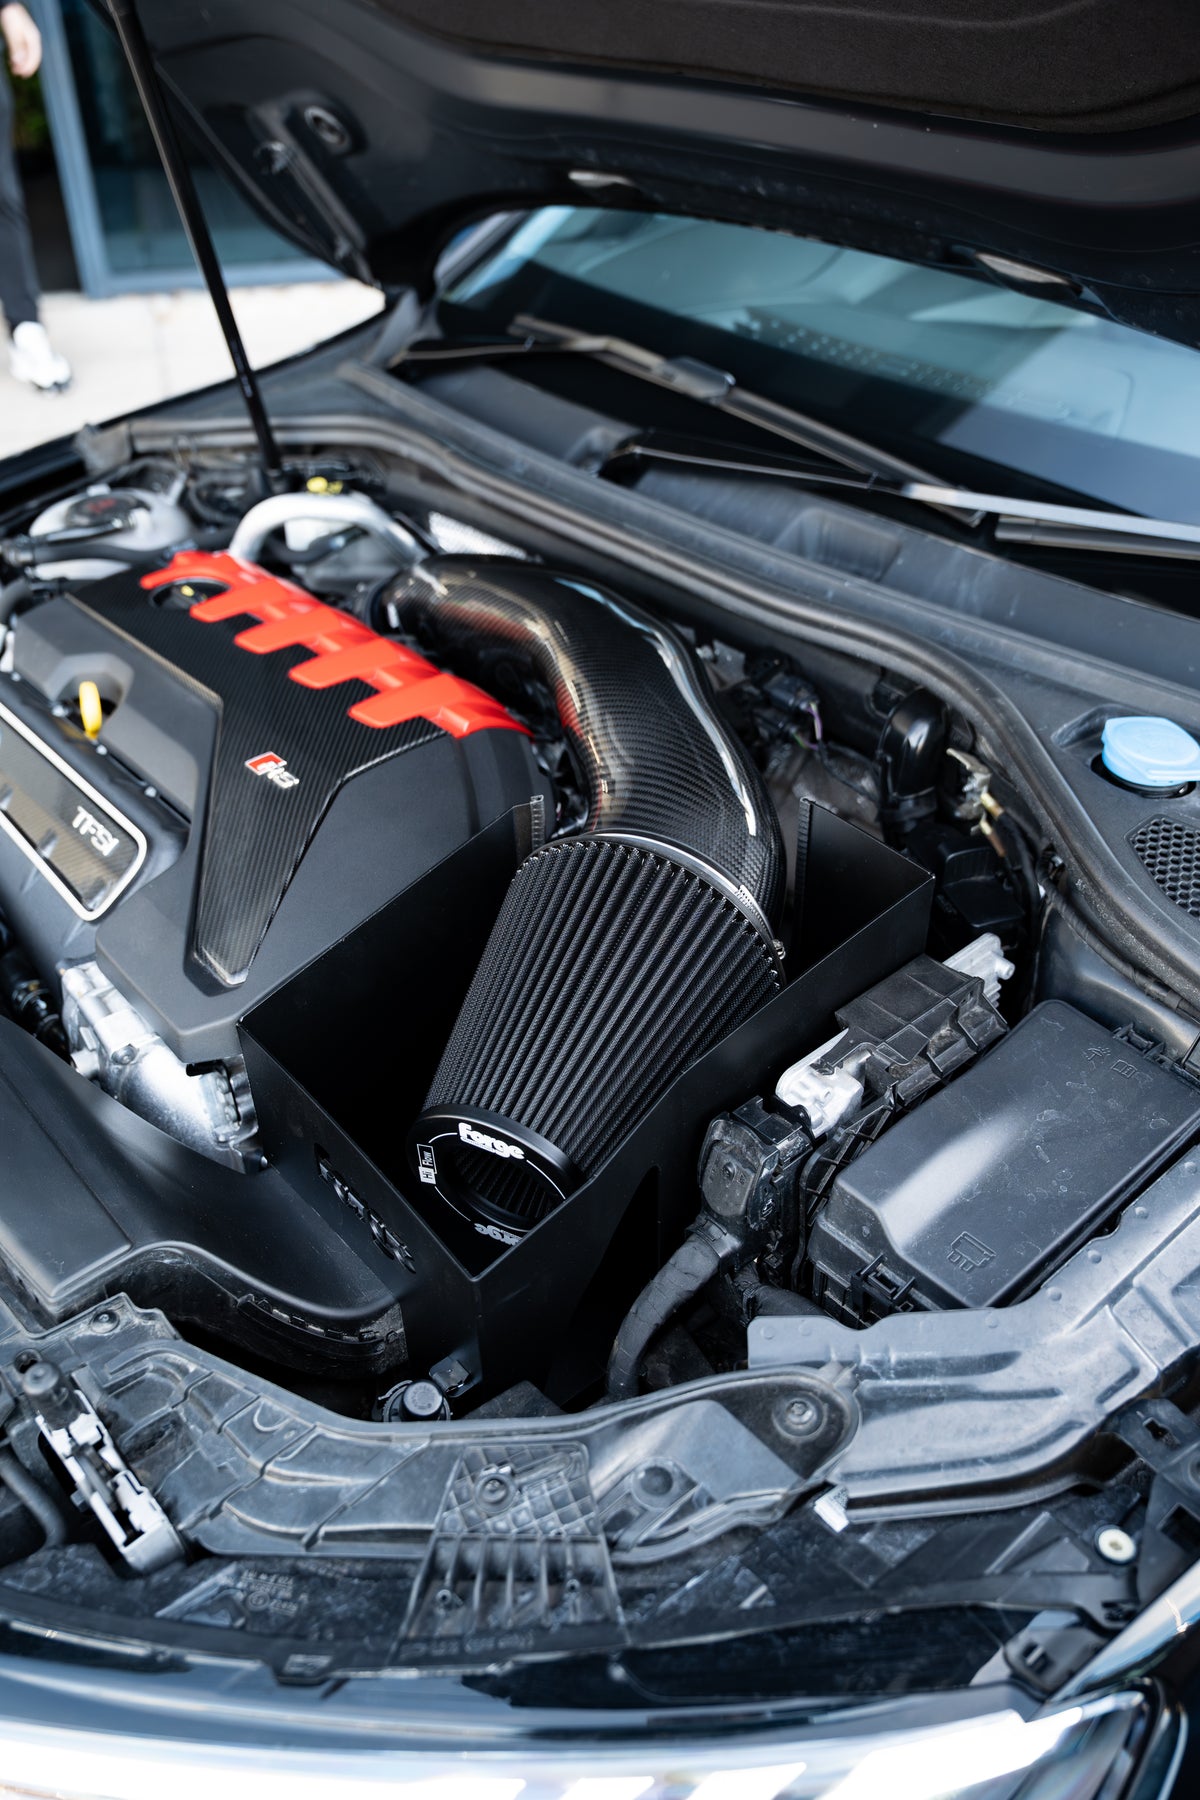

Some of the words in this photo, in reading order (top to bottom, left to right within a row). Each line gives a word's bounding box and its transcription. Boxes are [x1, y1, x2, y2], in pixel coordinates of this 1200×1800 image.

[72, 805, 119, 857] TFSI
[458, 1122, 525, 1160] Forge
[422, 1150, 434, 1167] Flow
[422, 1170, 433, 1180] Hi
